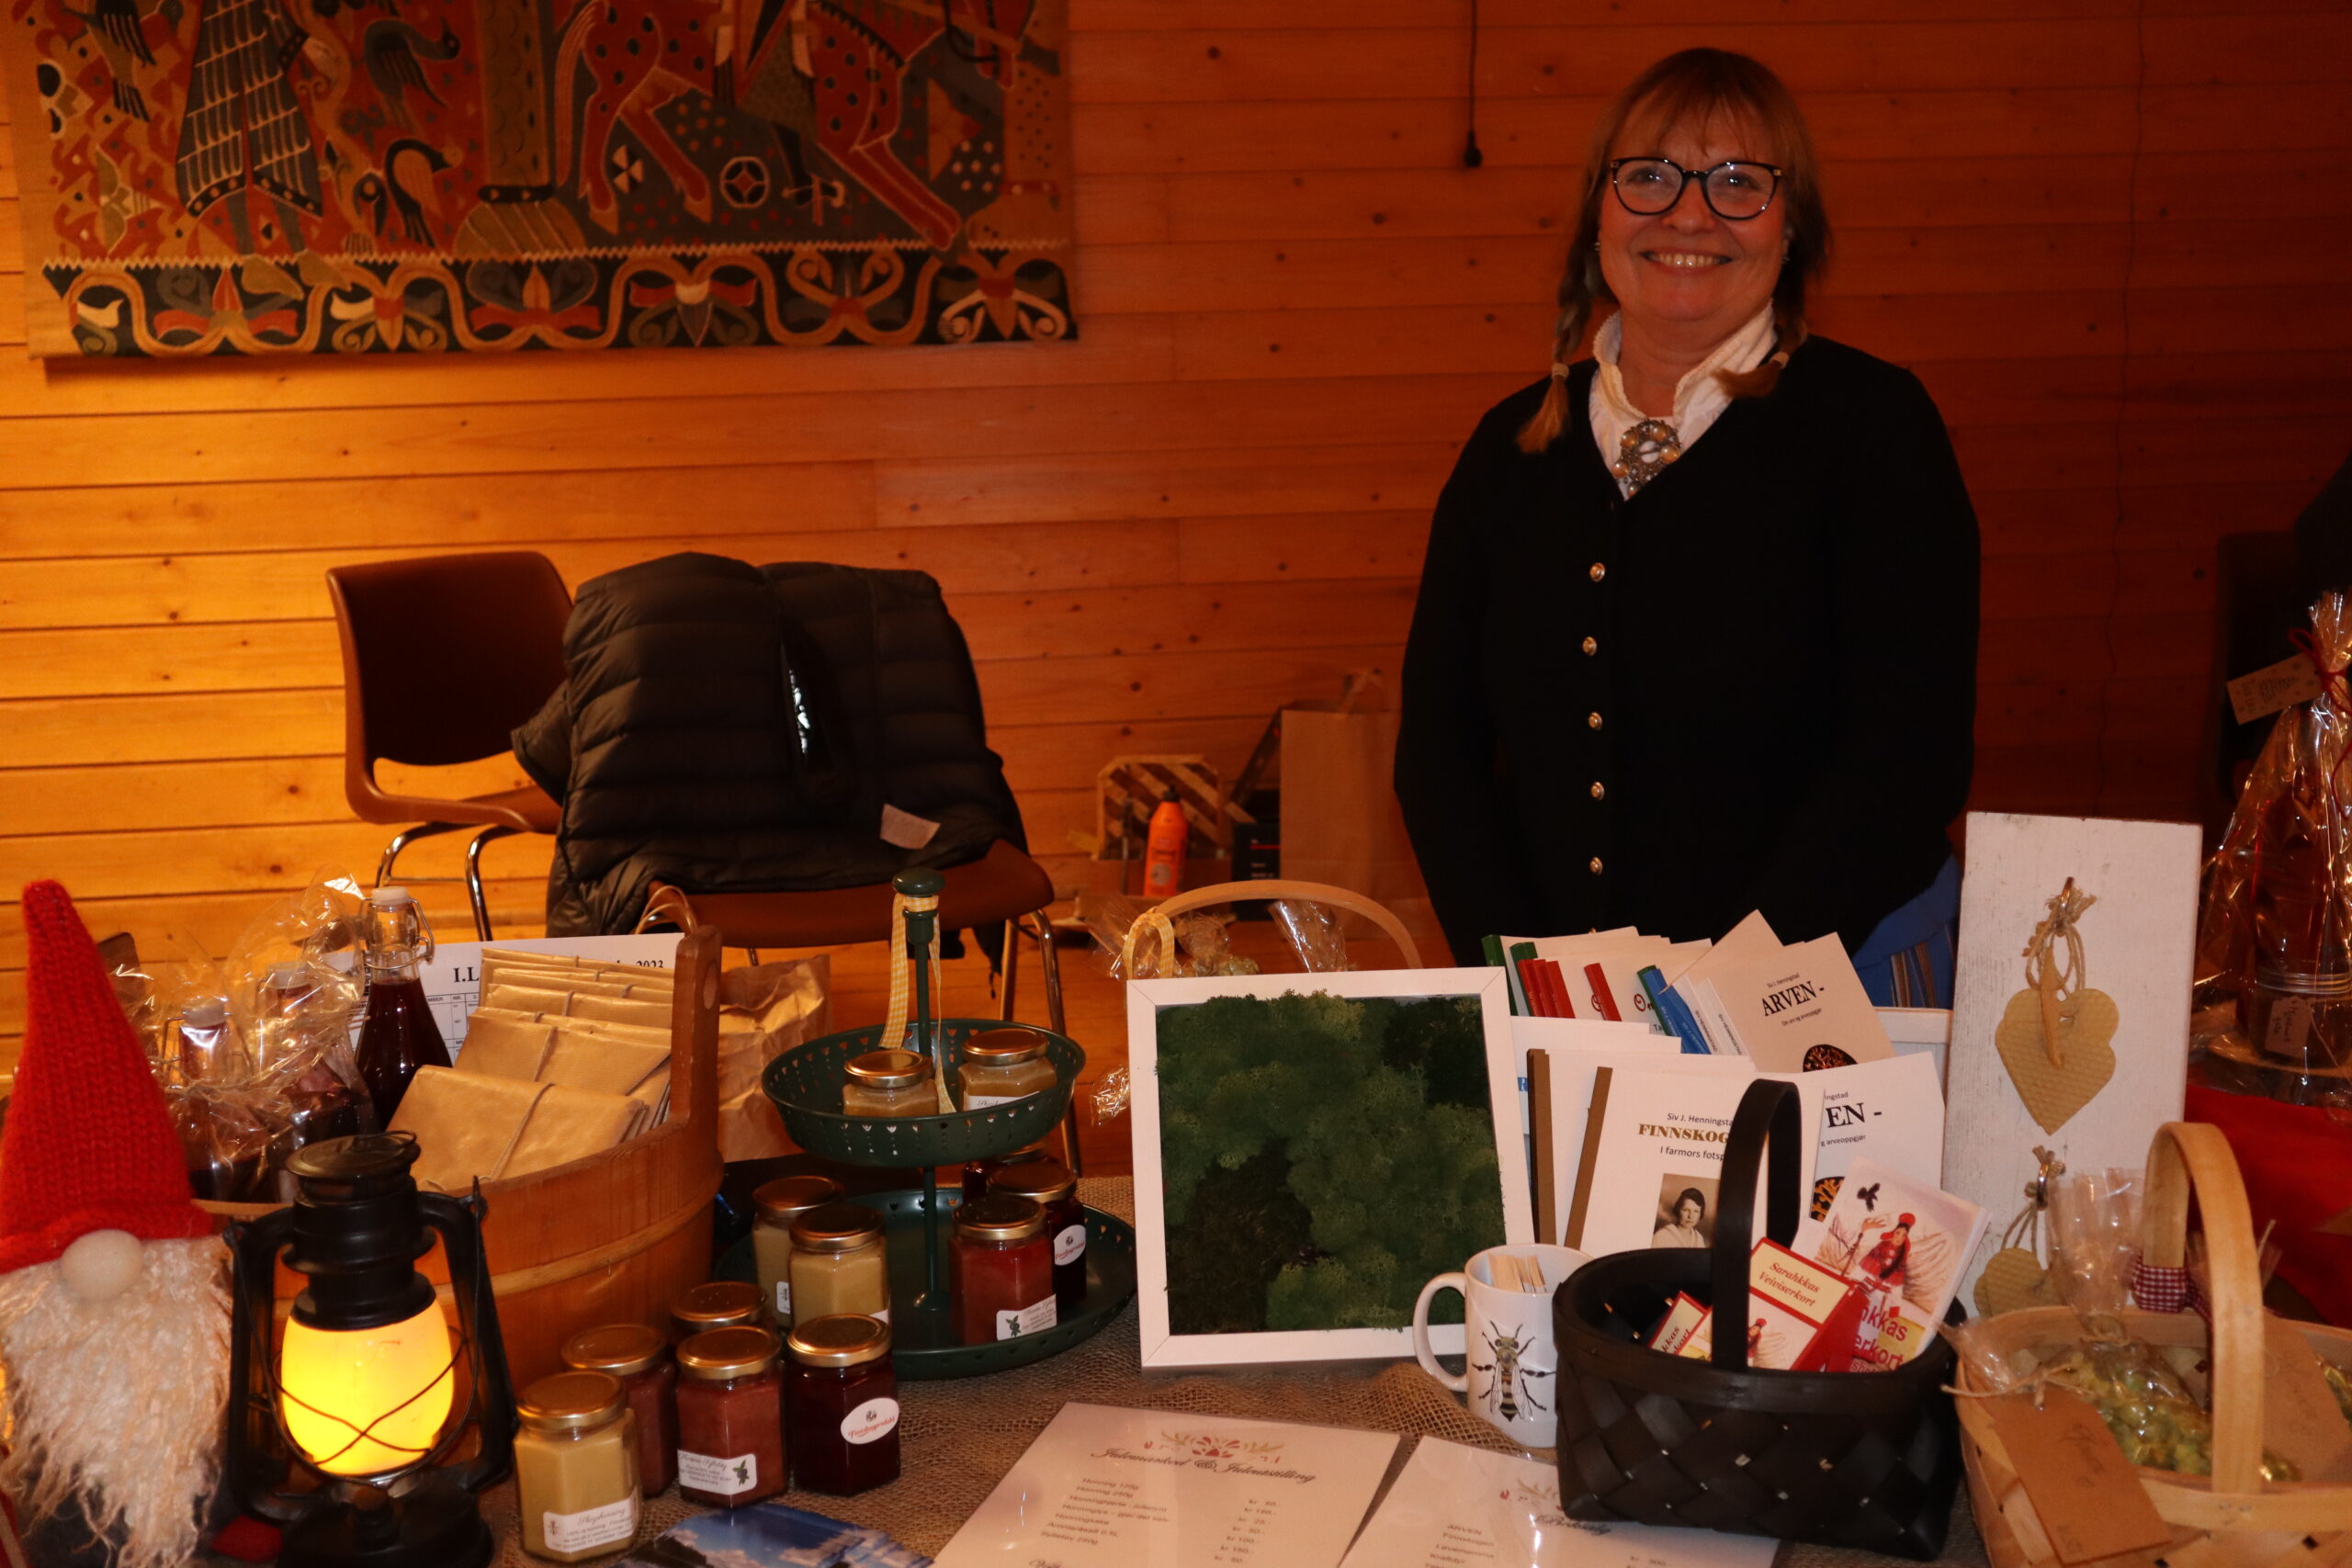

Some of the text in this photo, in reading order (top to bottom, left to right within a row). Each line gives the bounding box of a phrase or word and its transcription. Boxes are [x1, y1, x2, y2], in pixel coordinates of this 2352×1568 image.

[1761, 980, 1817, 1017] ARVEN
[1667, 1112, 1679, 1121] Siv
[1637, 1123, 1729, 1144] FINNSKOG
[1826, 1134, 1866, 1145] arveoppgjør
[1665, 1146, 1701, 1158] farmors
[1770, 1262, 1821, 1293] Sarahkkas
[1758, 1271, 1816, 1306] Veiviserkort
[1082, 1477, 1116, 1488] Honning
[1076, 1485, 1110, 1496] Honning
[1446, 1524, 1482, 1535] ARVEN
